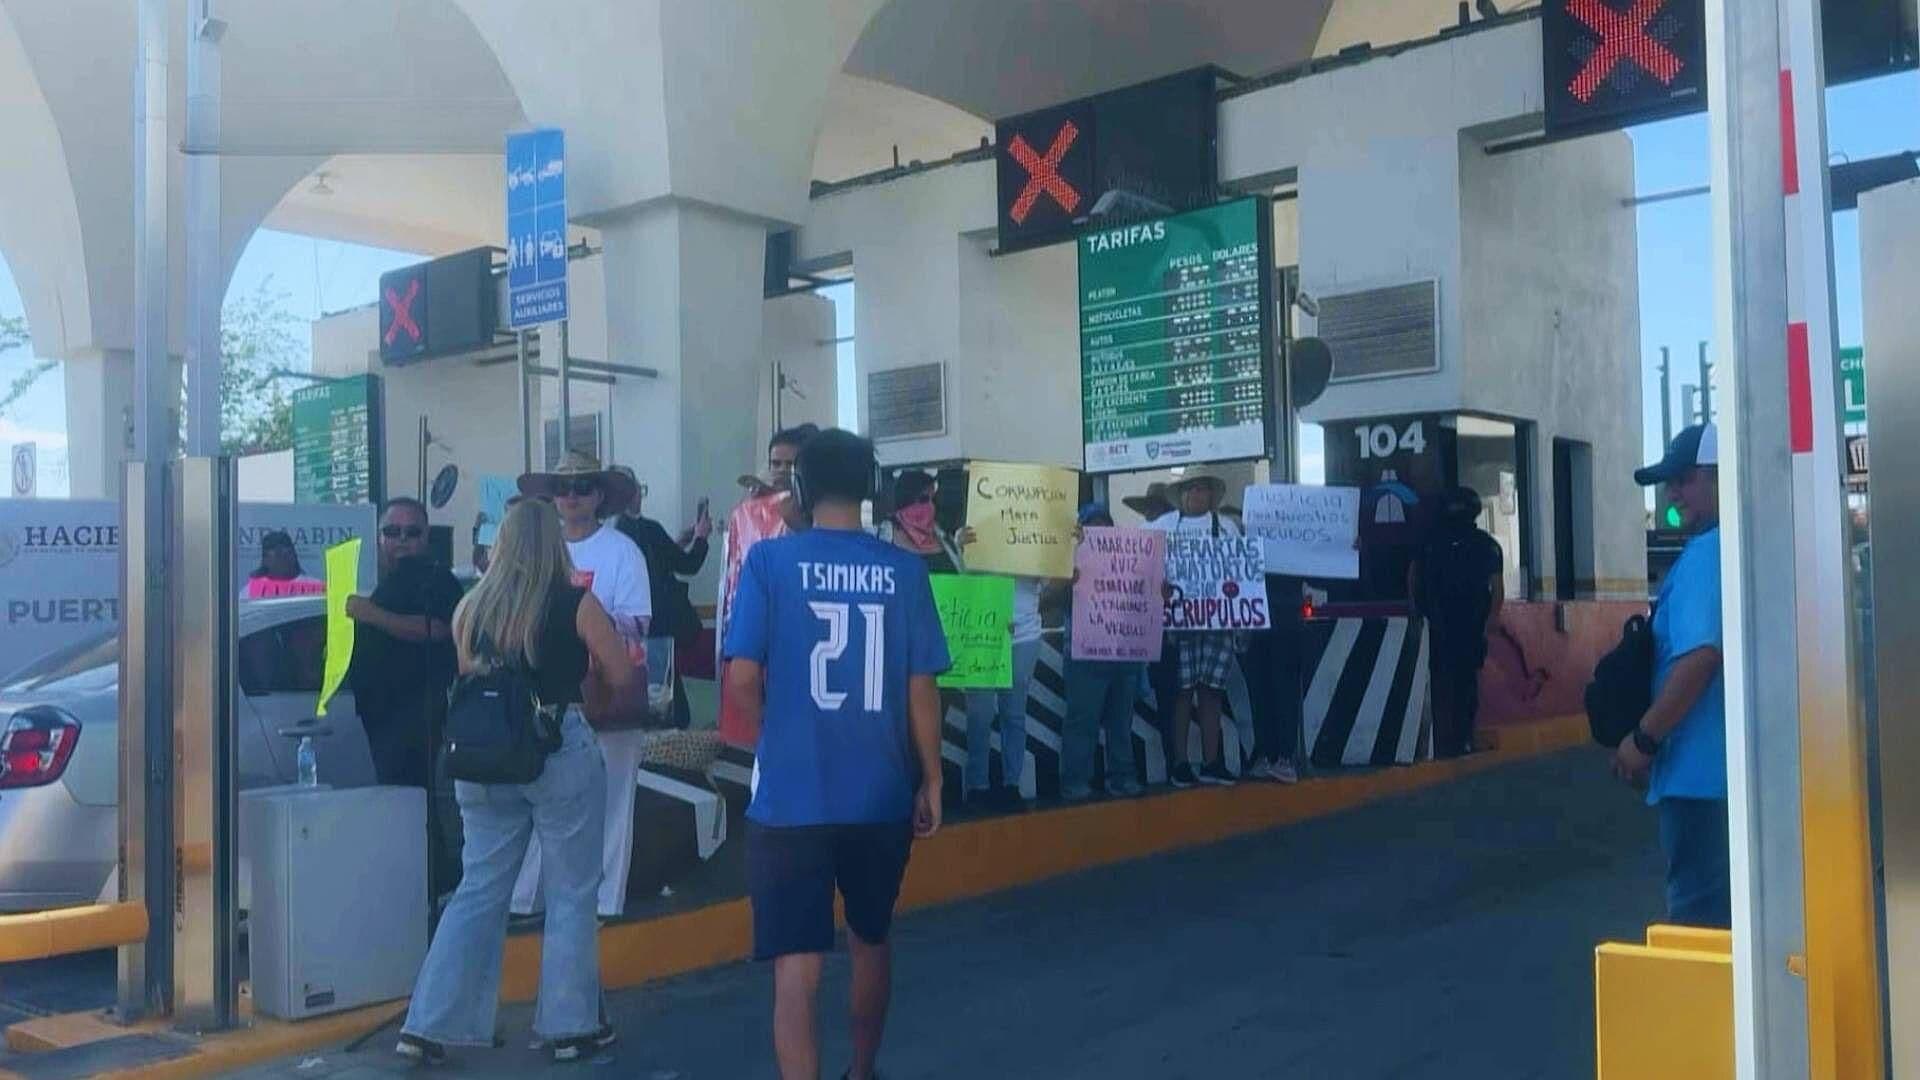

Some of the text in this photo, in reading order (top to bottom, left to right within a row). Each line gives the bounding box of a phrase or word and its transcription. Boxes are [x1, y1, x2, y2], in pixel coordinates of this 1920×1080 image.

[1087, 221, 1166, 253] TARIFAS
[514, 301, 564, 319] AUXILIARES
[516, 286, 561, 304] SERVICIOS
[1355, 421, 1427, 459] 104
[798, 562, 896, 594] TSIMIKAS
[808, 601, 885, 712] 21
